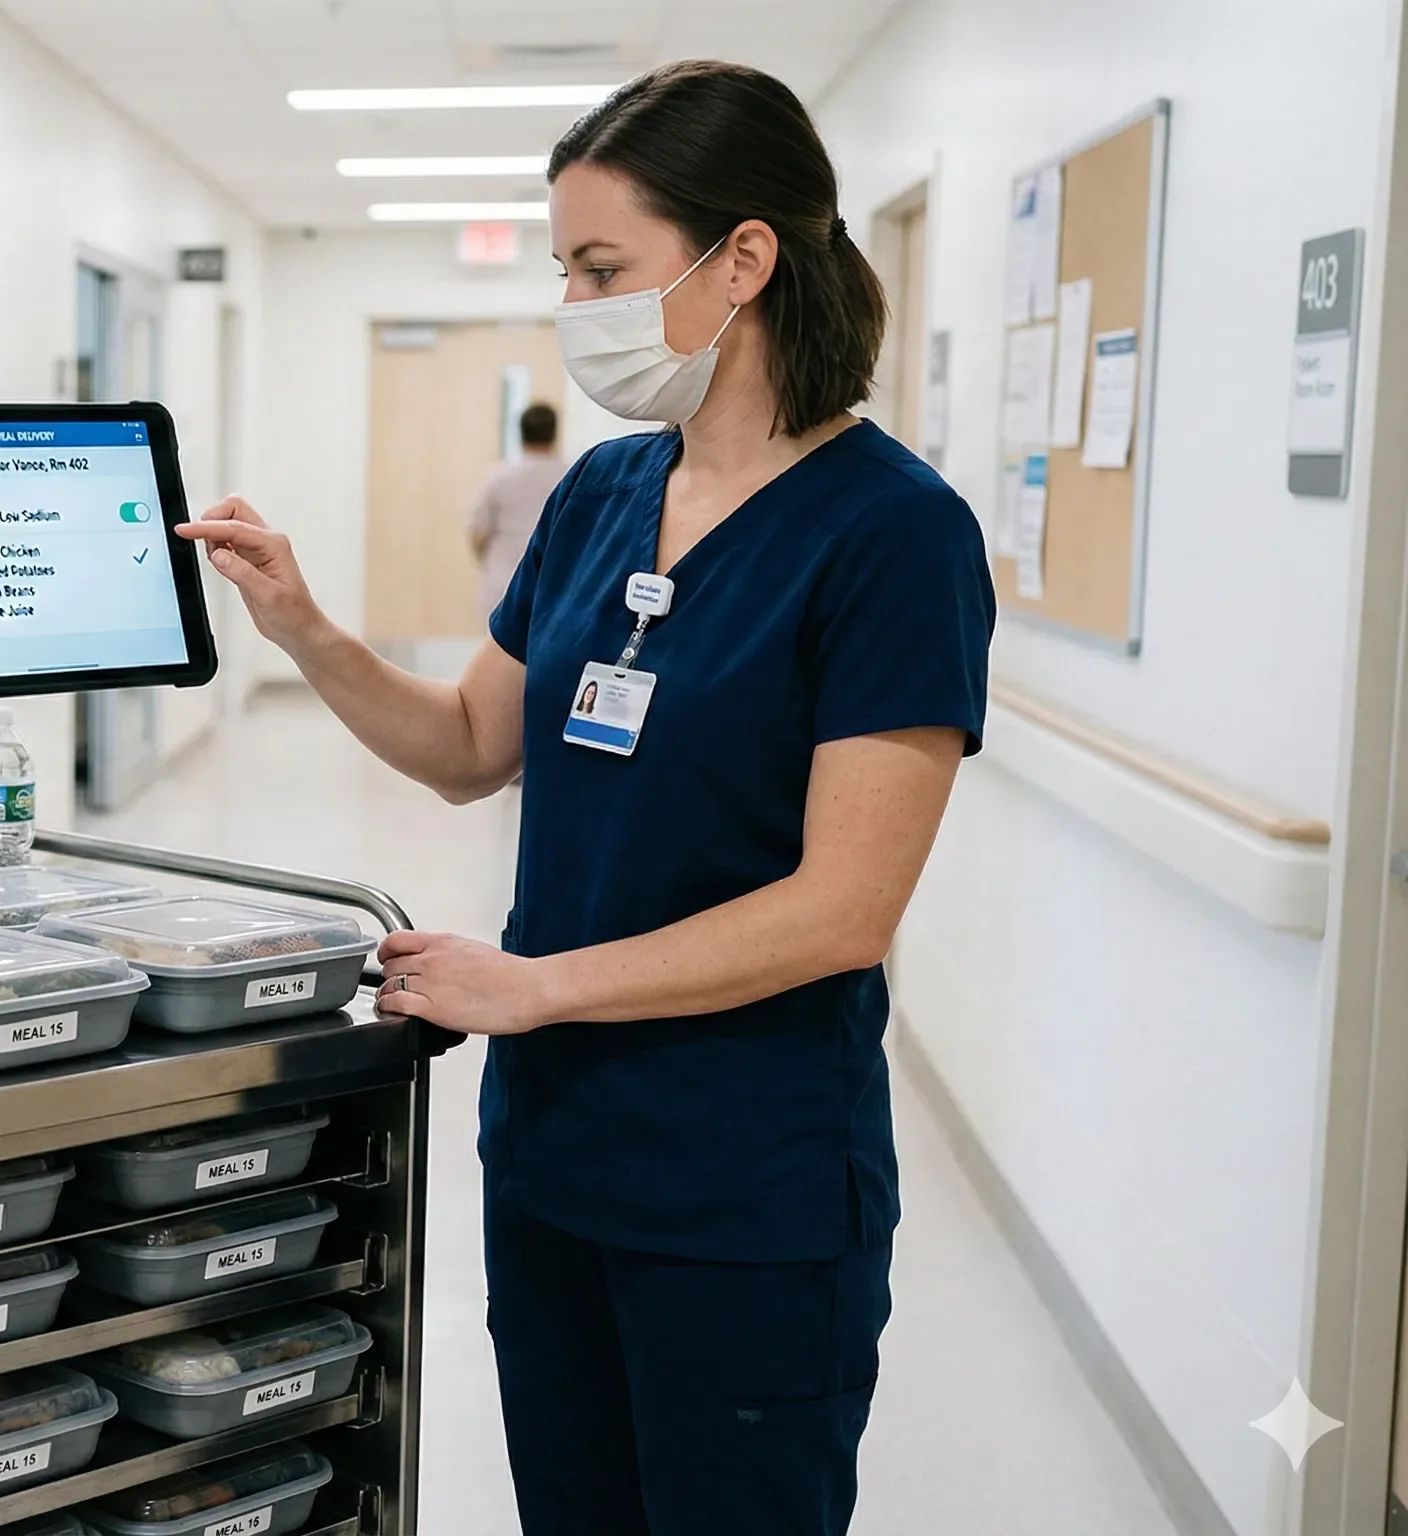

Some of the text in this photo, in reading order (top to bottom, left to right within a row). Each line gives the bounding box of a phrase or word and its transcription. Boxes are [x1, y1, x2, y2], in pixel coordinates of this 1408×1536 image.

[1301, 252, 1339, 310] 403
[49, 457, 67, 471] Rm
[68, 457, 90, 471] 402
[0, 544, 41, 558] Chicken
[10, 564, 56, 577] Potatoes
[3, 585, 35, 597] Beans
[8, 603, 34, 616] Juice
[259, 980, 304, 998] MEAL 16
[12, 1022, 63, 1042] MEAL 15
[208, 1158, 254, 1178] MEAL 15
[217, 1248, 263, 1268] MEAL 15
[256, 1380, 302, 1404] MEAL 15
[22, 1453, 36, 1467] 15
[215, 1516, 260, 1536] MEAL 16
